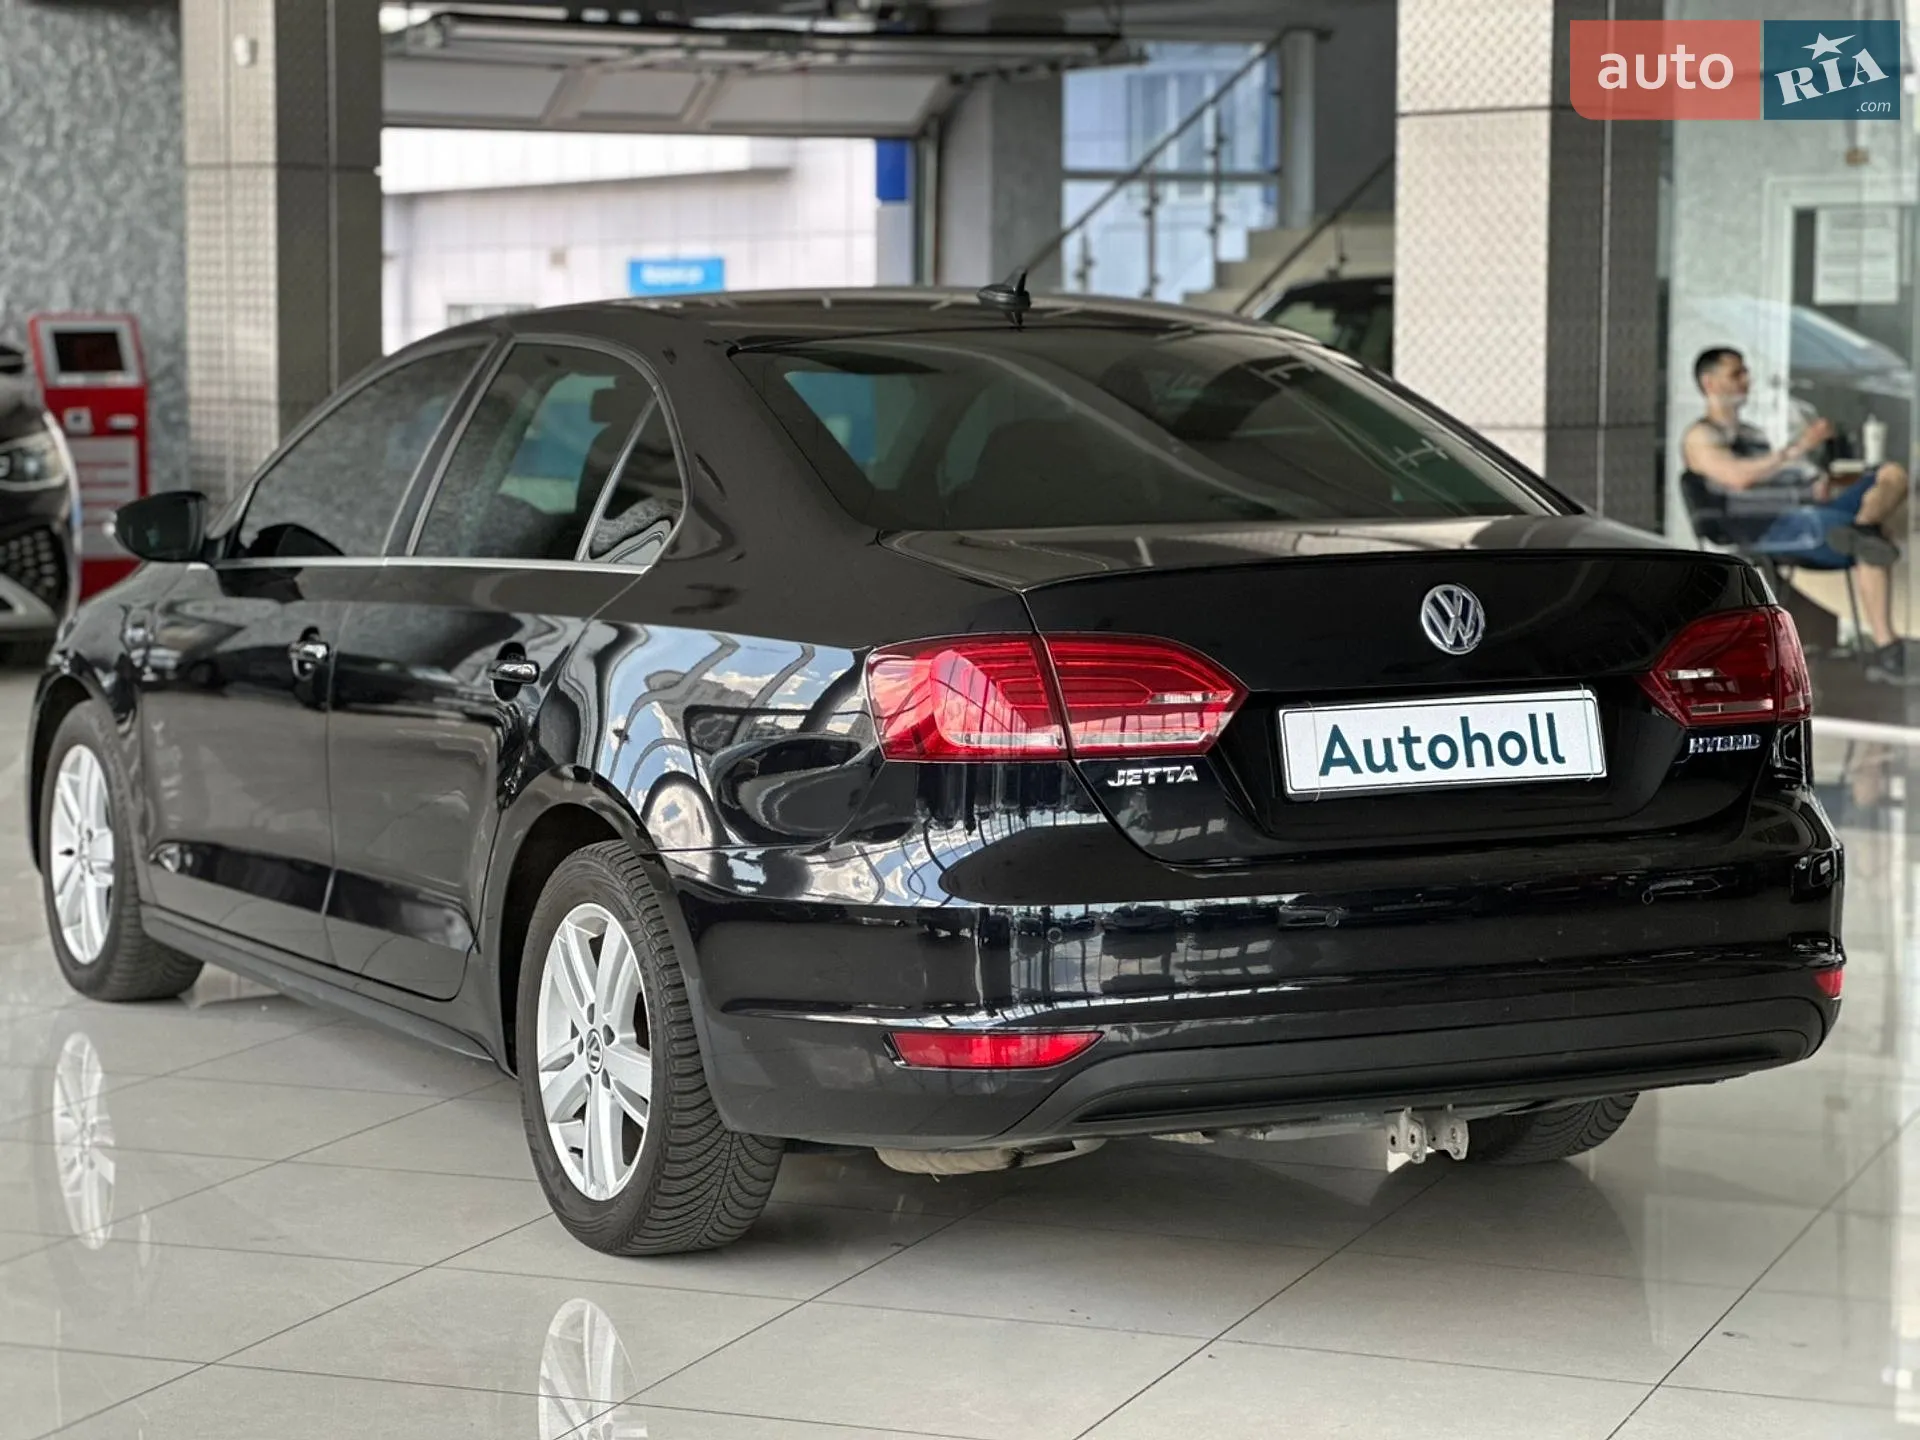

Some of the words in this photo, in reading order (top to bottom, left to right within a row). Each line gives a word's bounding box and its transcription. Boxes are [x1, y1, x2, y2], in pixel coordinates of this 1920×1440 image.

[1318, 712, 1566, 777] Autoholl
[1688, 733, 1761, 754] HYBRID
[1107, 765, 1199, 787] JETTA
